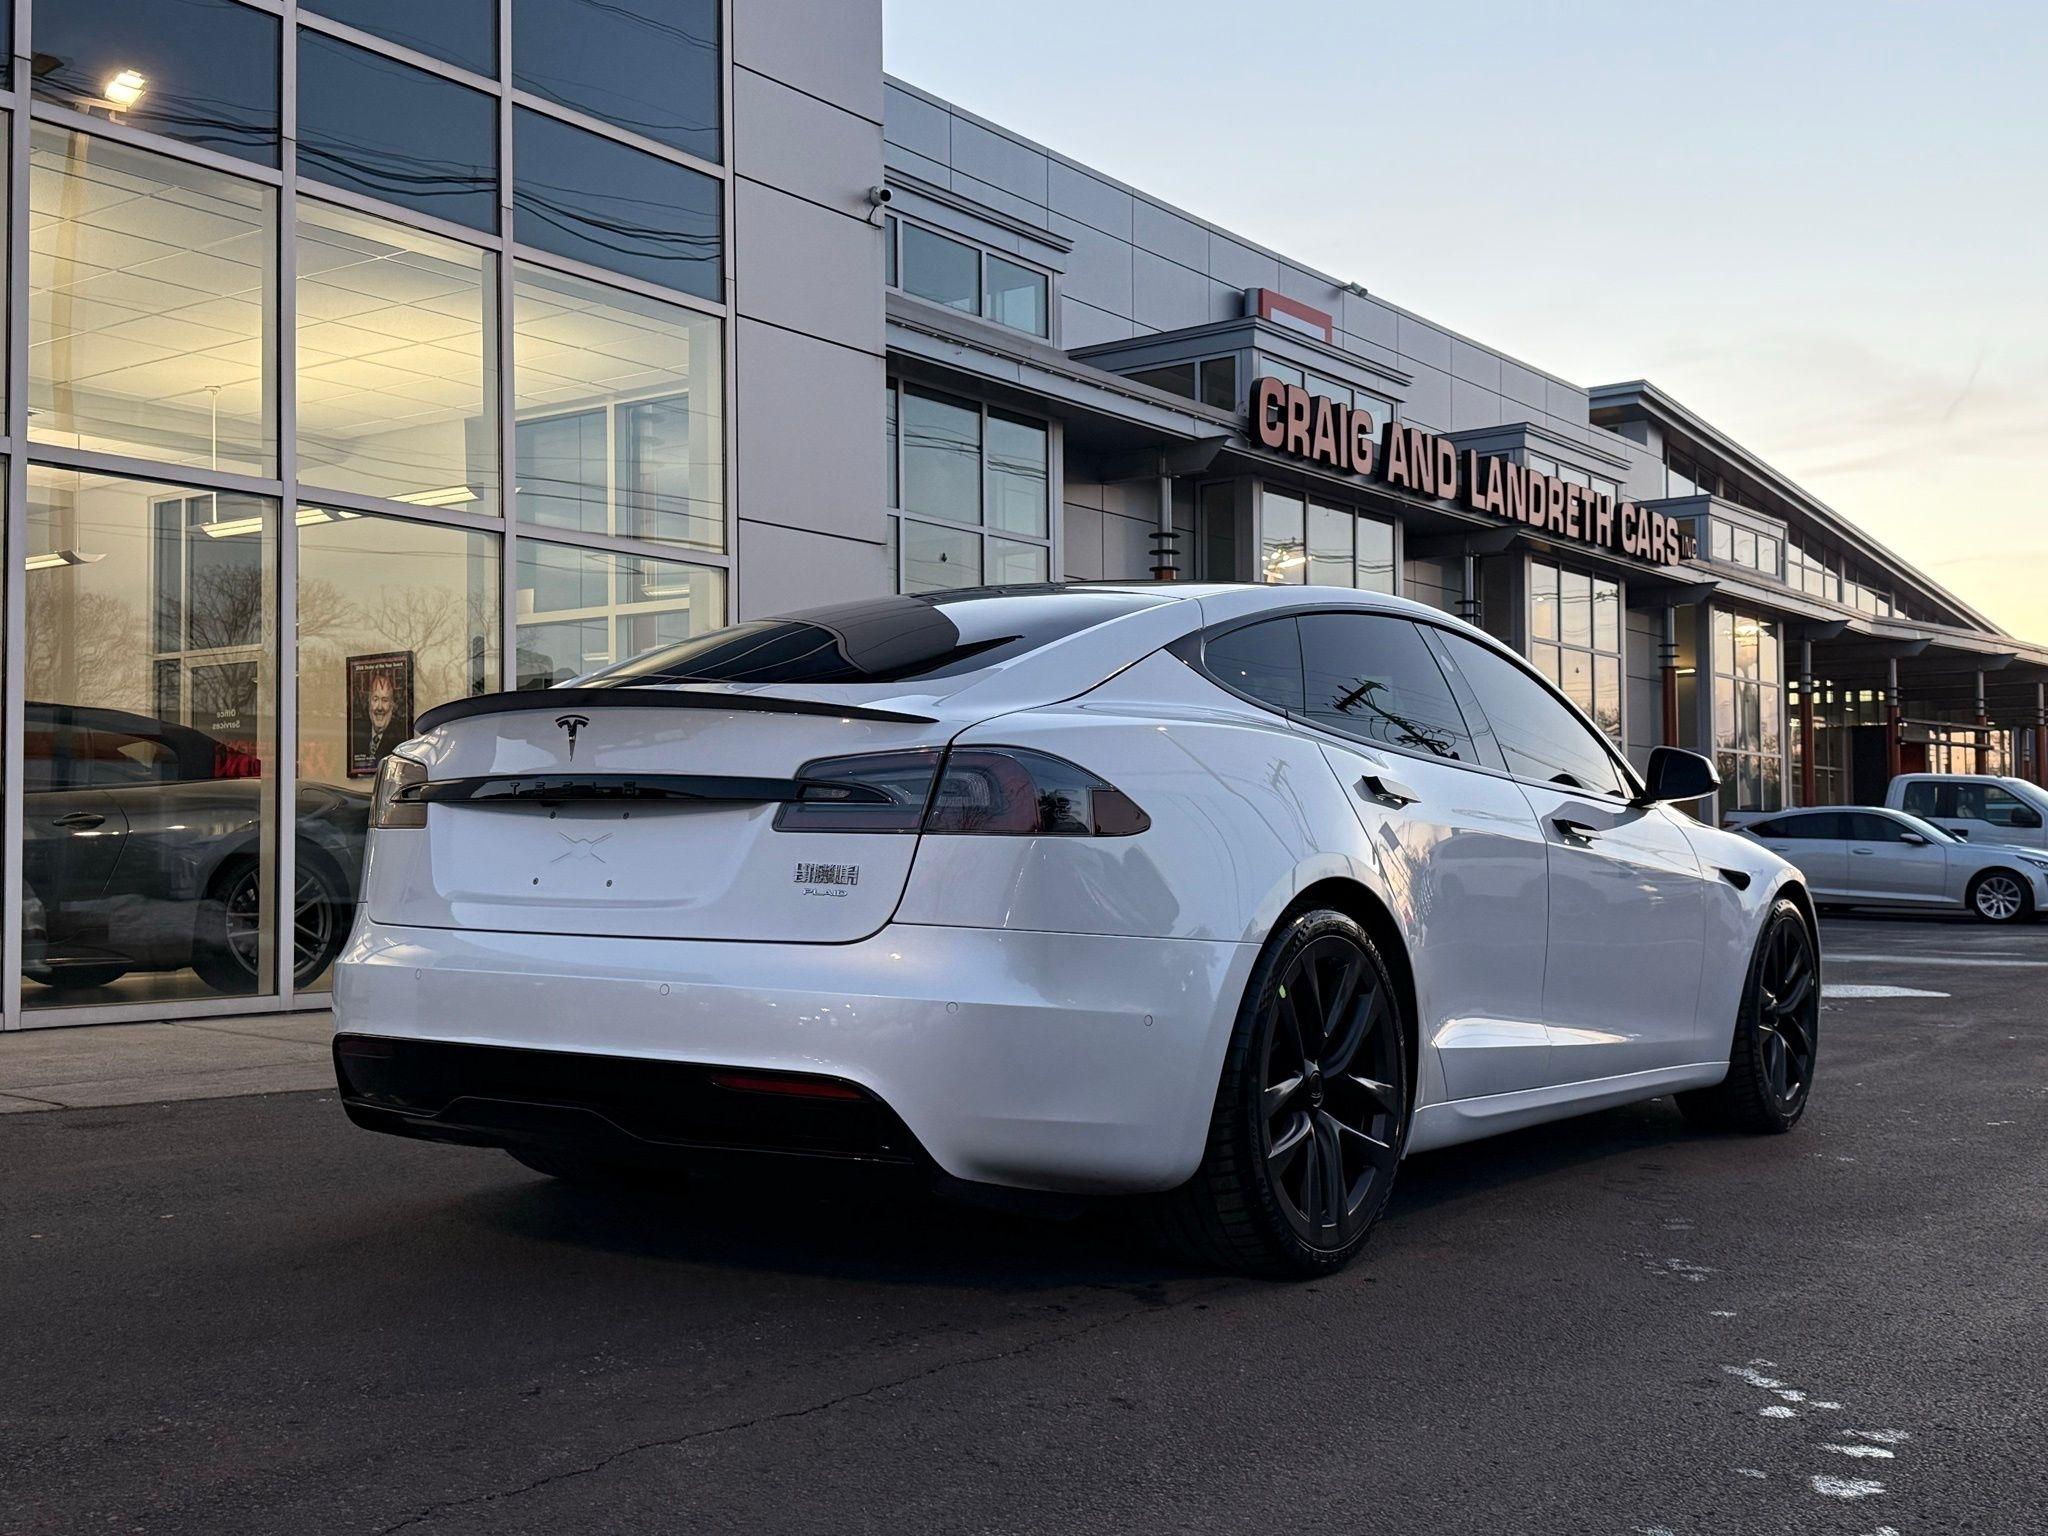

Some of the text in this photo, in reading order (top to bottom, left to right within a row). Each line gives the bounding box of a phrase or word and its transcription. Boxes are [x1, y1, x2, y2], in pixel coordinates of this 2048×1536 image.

[1257, 375, 1374, 475] CRAIG
[1387, 421, 1457, 500] AND
[1470, 448, 1612, 547] LANDRETH
[1622, 502, 1680, 566] CARS
[801, 888, 848, 897] PLAID
